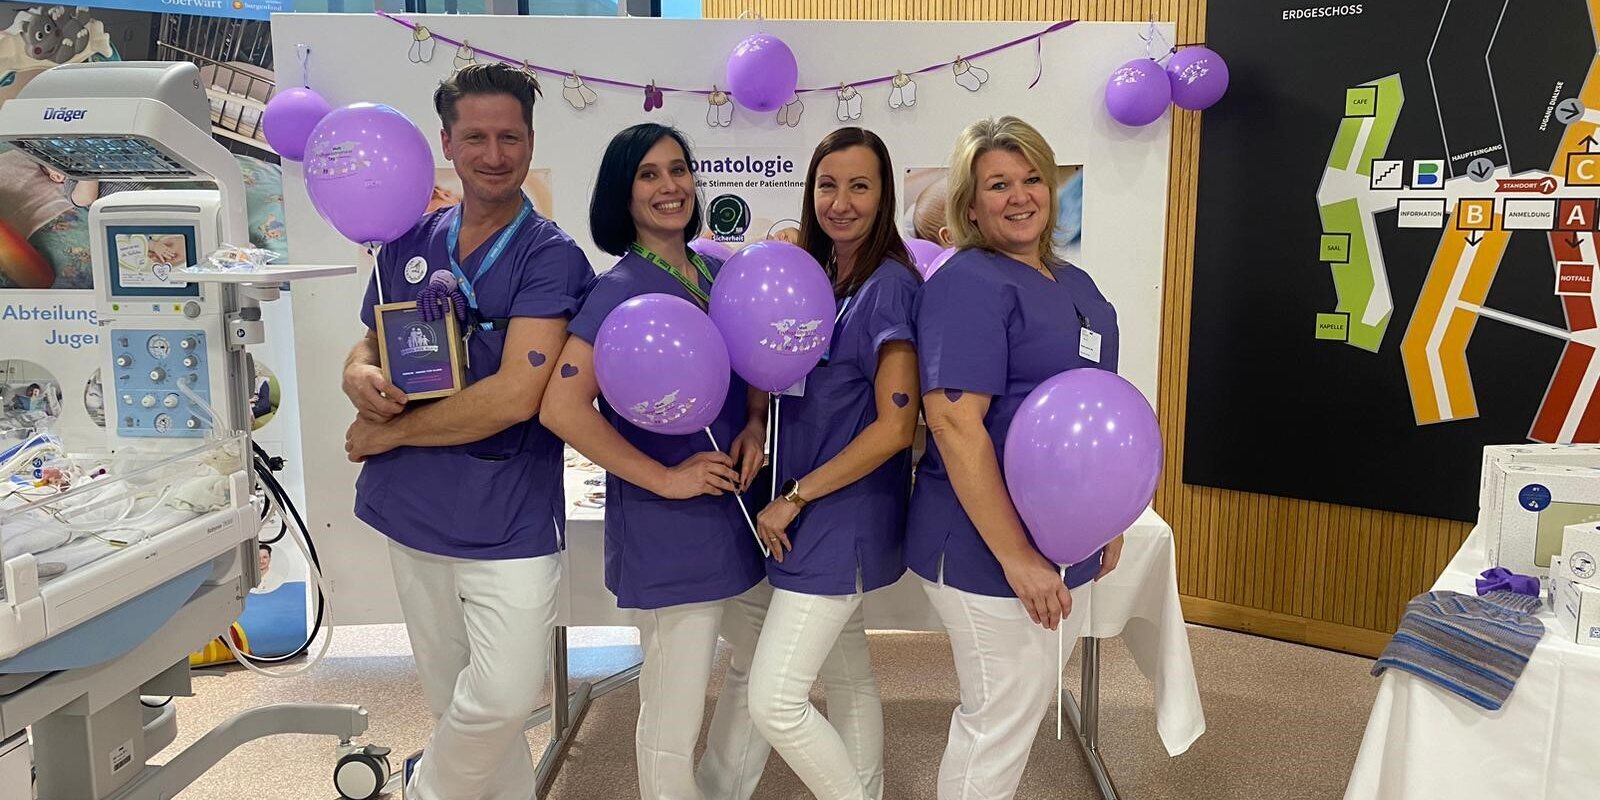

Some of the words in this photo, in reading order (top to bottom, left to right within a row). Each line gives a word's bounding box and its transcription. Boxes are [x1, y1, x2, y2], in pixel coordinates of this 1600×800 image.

[1282, 4, 1363, 20] ERDGESCHOSS
[1539, 106, 1554, 131] ZUGANG
[1549, 81, 1564, 106] DIALYSE
[43, 107, 88, 122] Dräger
[1451, 144, 1503, 162] HAUPTEINGANG
[1576, 159, 1595, 180] C
[709, 180, 744, 188] Stimmen
[745, 180, 758, 188] der
[760, 180, 806, 188] PatientInne
[1503, 182, 1538, 190] STANDORT
[1400, 210, 1443, 218] INFORMATION
[1466, 204, 1484, 225] B
[1508, 209, 1551, 219] ANMELDUNG
[1566, 205, 1586, 226] A
[1327, 243, 1342, 251] SAAL
[1560, 274, 1592, 283] NOTFALL
[2, 304, 97, 325] Abteilung
[1319, 323, 1344, 331] KAPELLE
